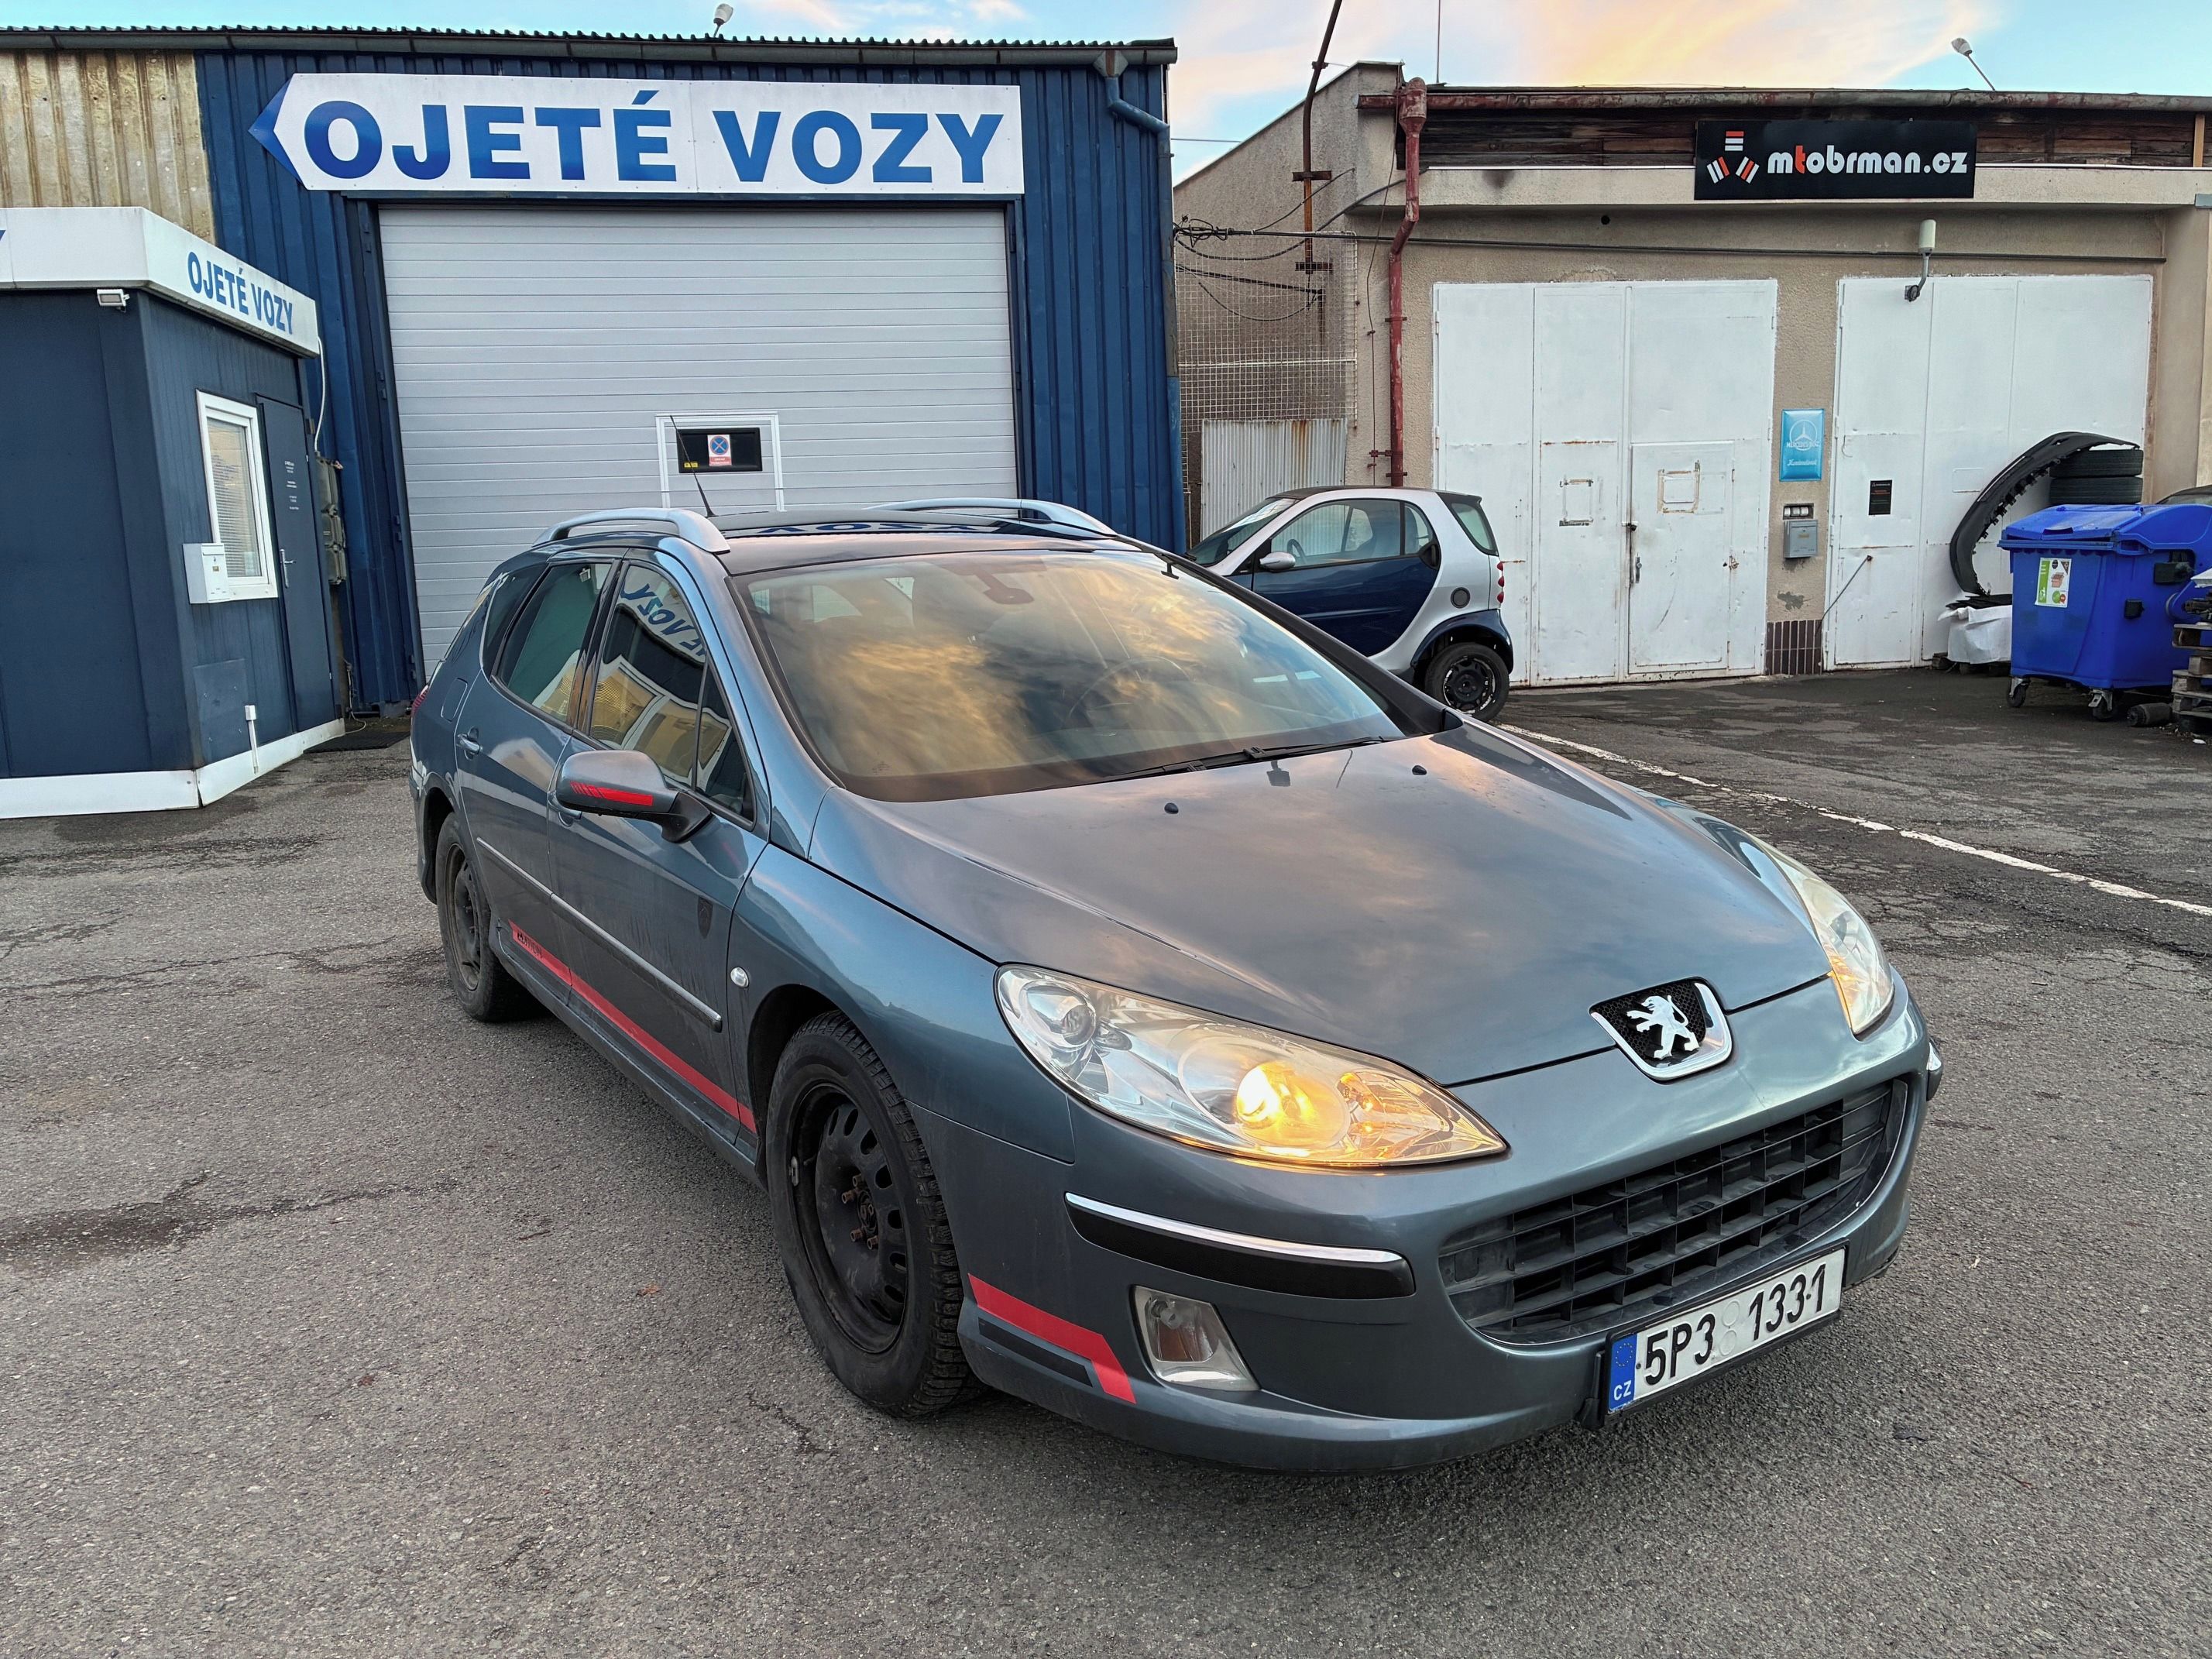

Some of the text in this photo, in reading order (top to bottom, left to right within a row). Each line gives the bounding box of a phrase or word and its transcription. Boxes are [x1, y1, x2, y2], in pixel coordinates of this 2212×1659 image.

[304, 90, 1004, 185] OJETÉ VOZY
[1767, 144, 1968, 175] mtobrman.cz
[187, 251, 293, 335] OJETÉ VOZY
[1644, 1262, 1826, 1386] 5P3 1331
[1613, 1379, 1632, 1402] CZ
